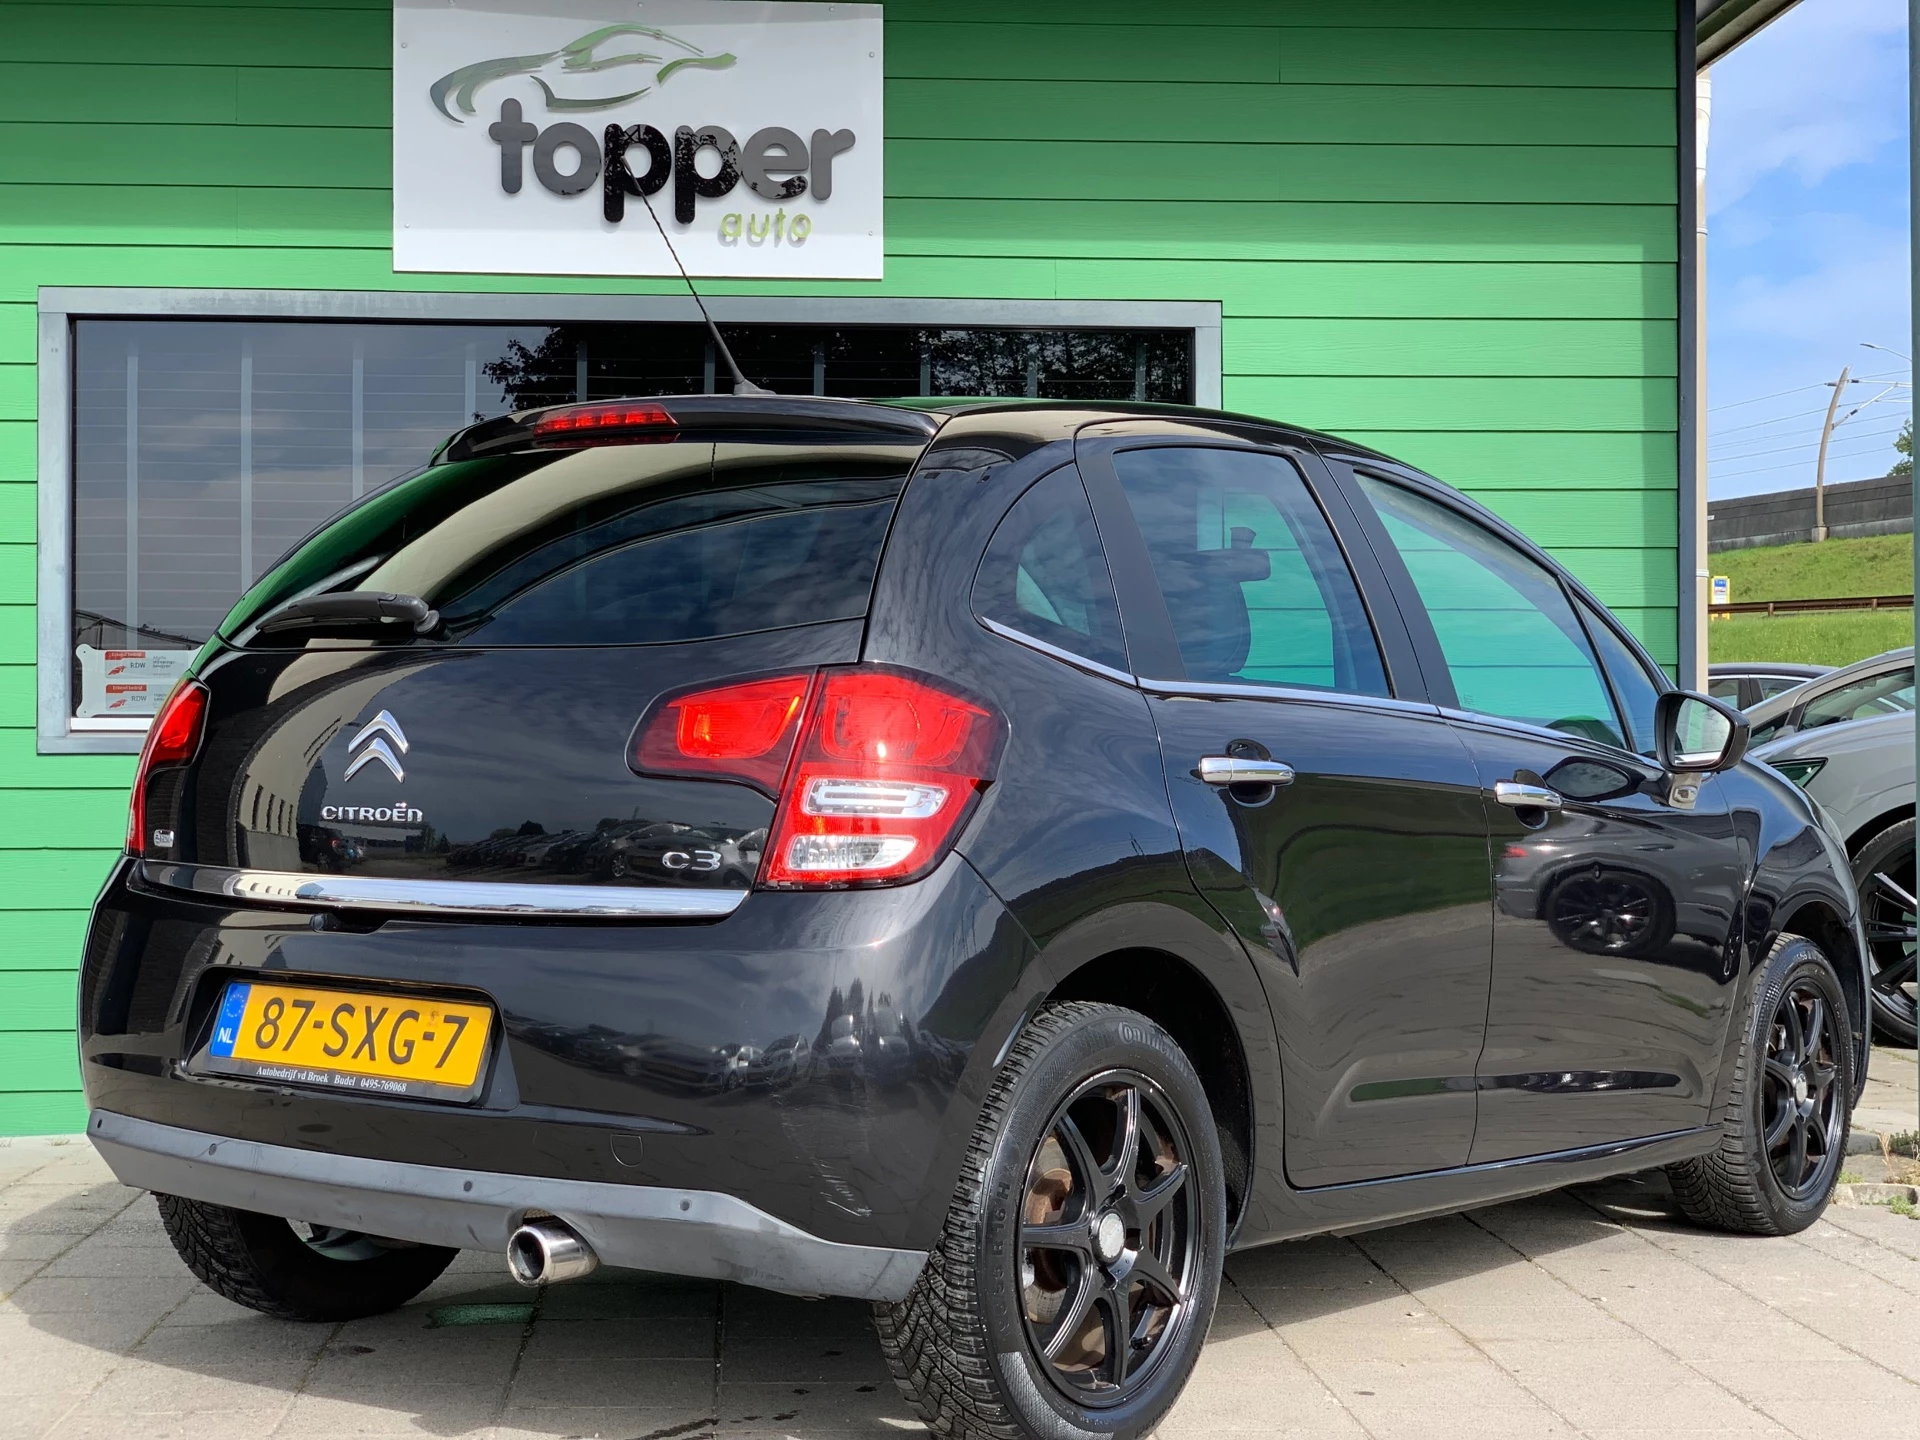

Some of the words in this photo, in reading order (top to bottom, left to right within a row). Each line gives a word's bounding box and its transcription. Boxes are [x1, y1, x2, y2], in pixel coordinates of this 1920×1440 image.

[488, 97, 856, 224] topper
[721, 207, 812, 239] auto
[662, 850, 721, 871] C3
[217, 1027, 233, 1045] NL
[255, 997, 469, 1069] 87-SXG-7
[256, 1066, 297, 1081] Autobedrijf
[298, 1072, 306, 1080] vd
[307, 1072, 329, 1083] Broek
[334, 1075, 356, 1087] Budel
[360, 1078, 408, 1092] 0495-769068
